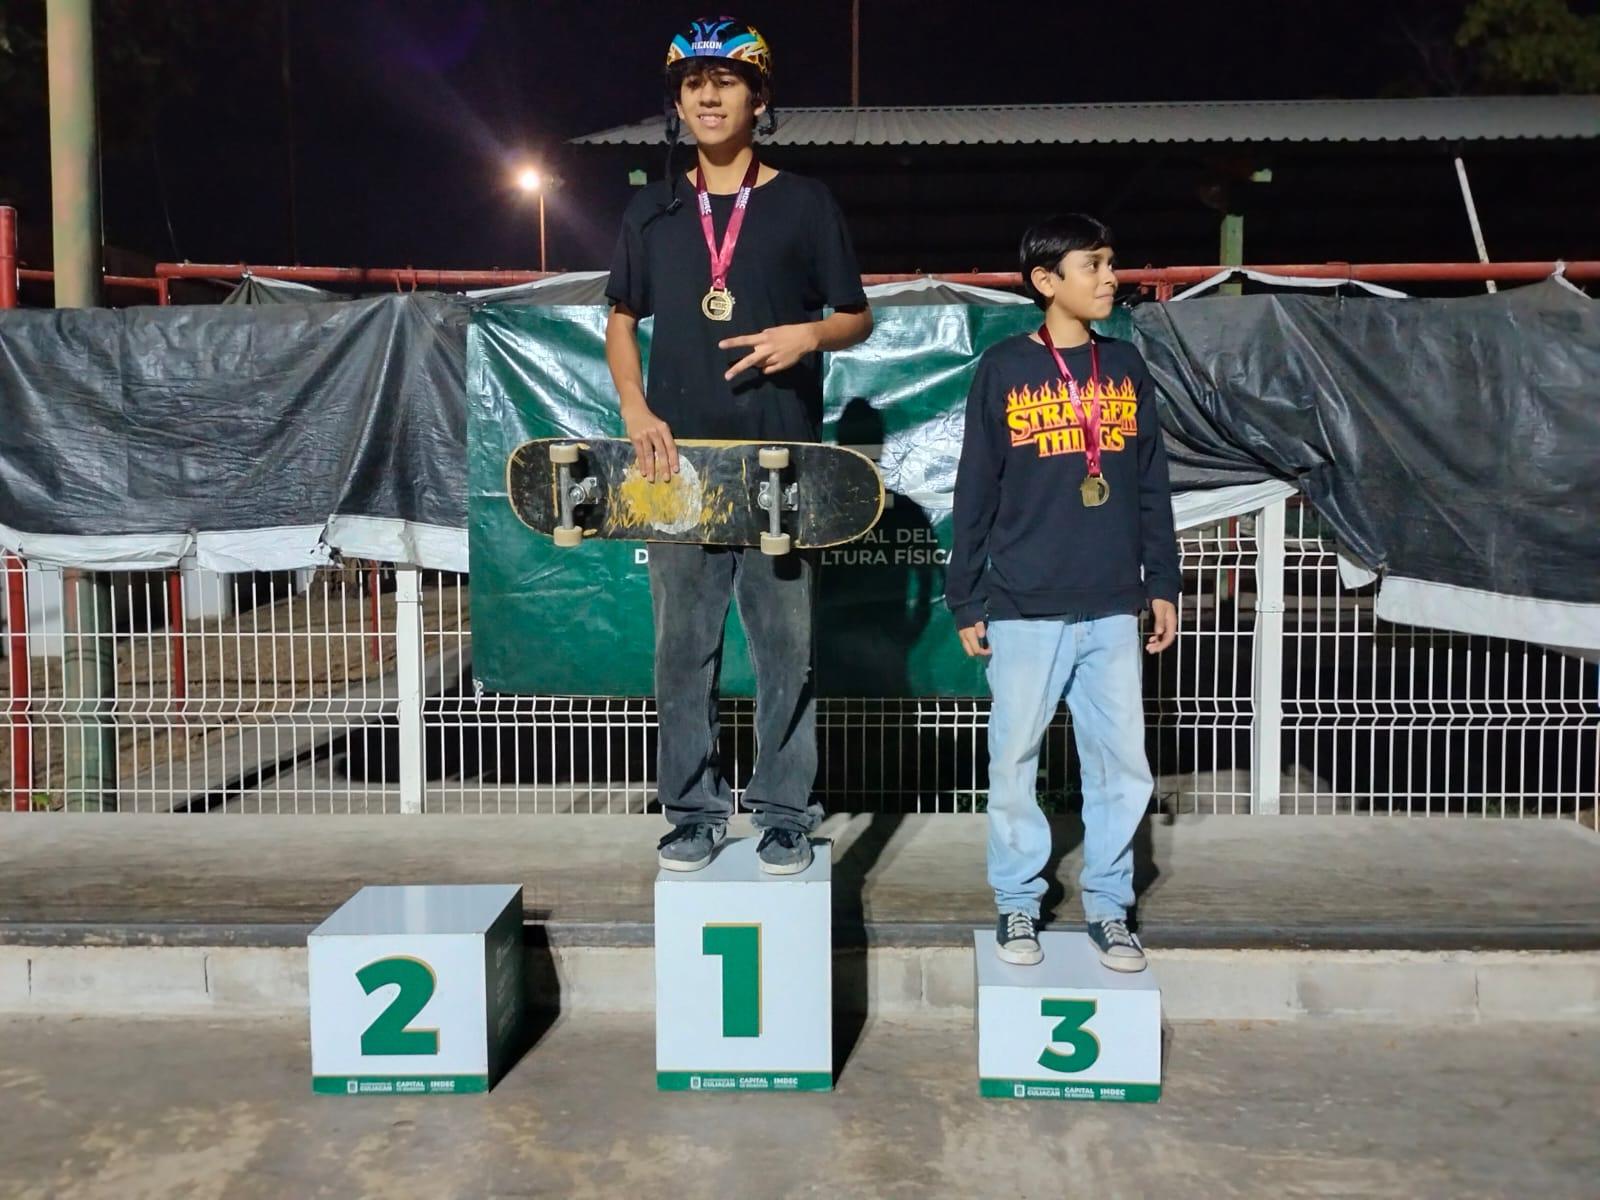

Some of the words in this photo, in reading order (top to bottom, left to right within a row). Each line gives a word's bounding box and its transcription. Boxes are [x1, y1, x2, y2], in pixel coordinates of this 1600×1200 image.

[691, 40, 723, 50] REKON
[821, 550, 888, 565] LTURA
[896, 528, 938, 544] DEL
[702, 922, 762, 1038] 1
[355, 955, 440, 1056] 2
[1037, 998, 1100, 1073] 3
